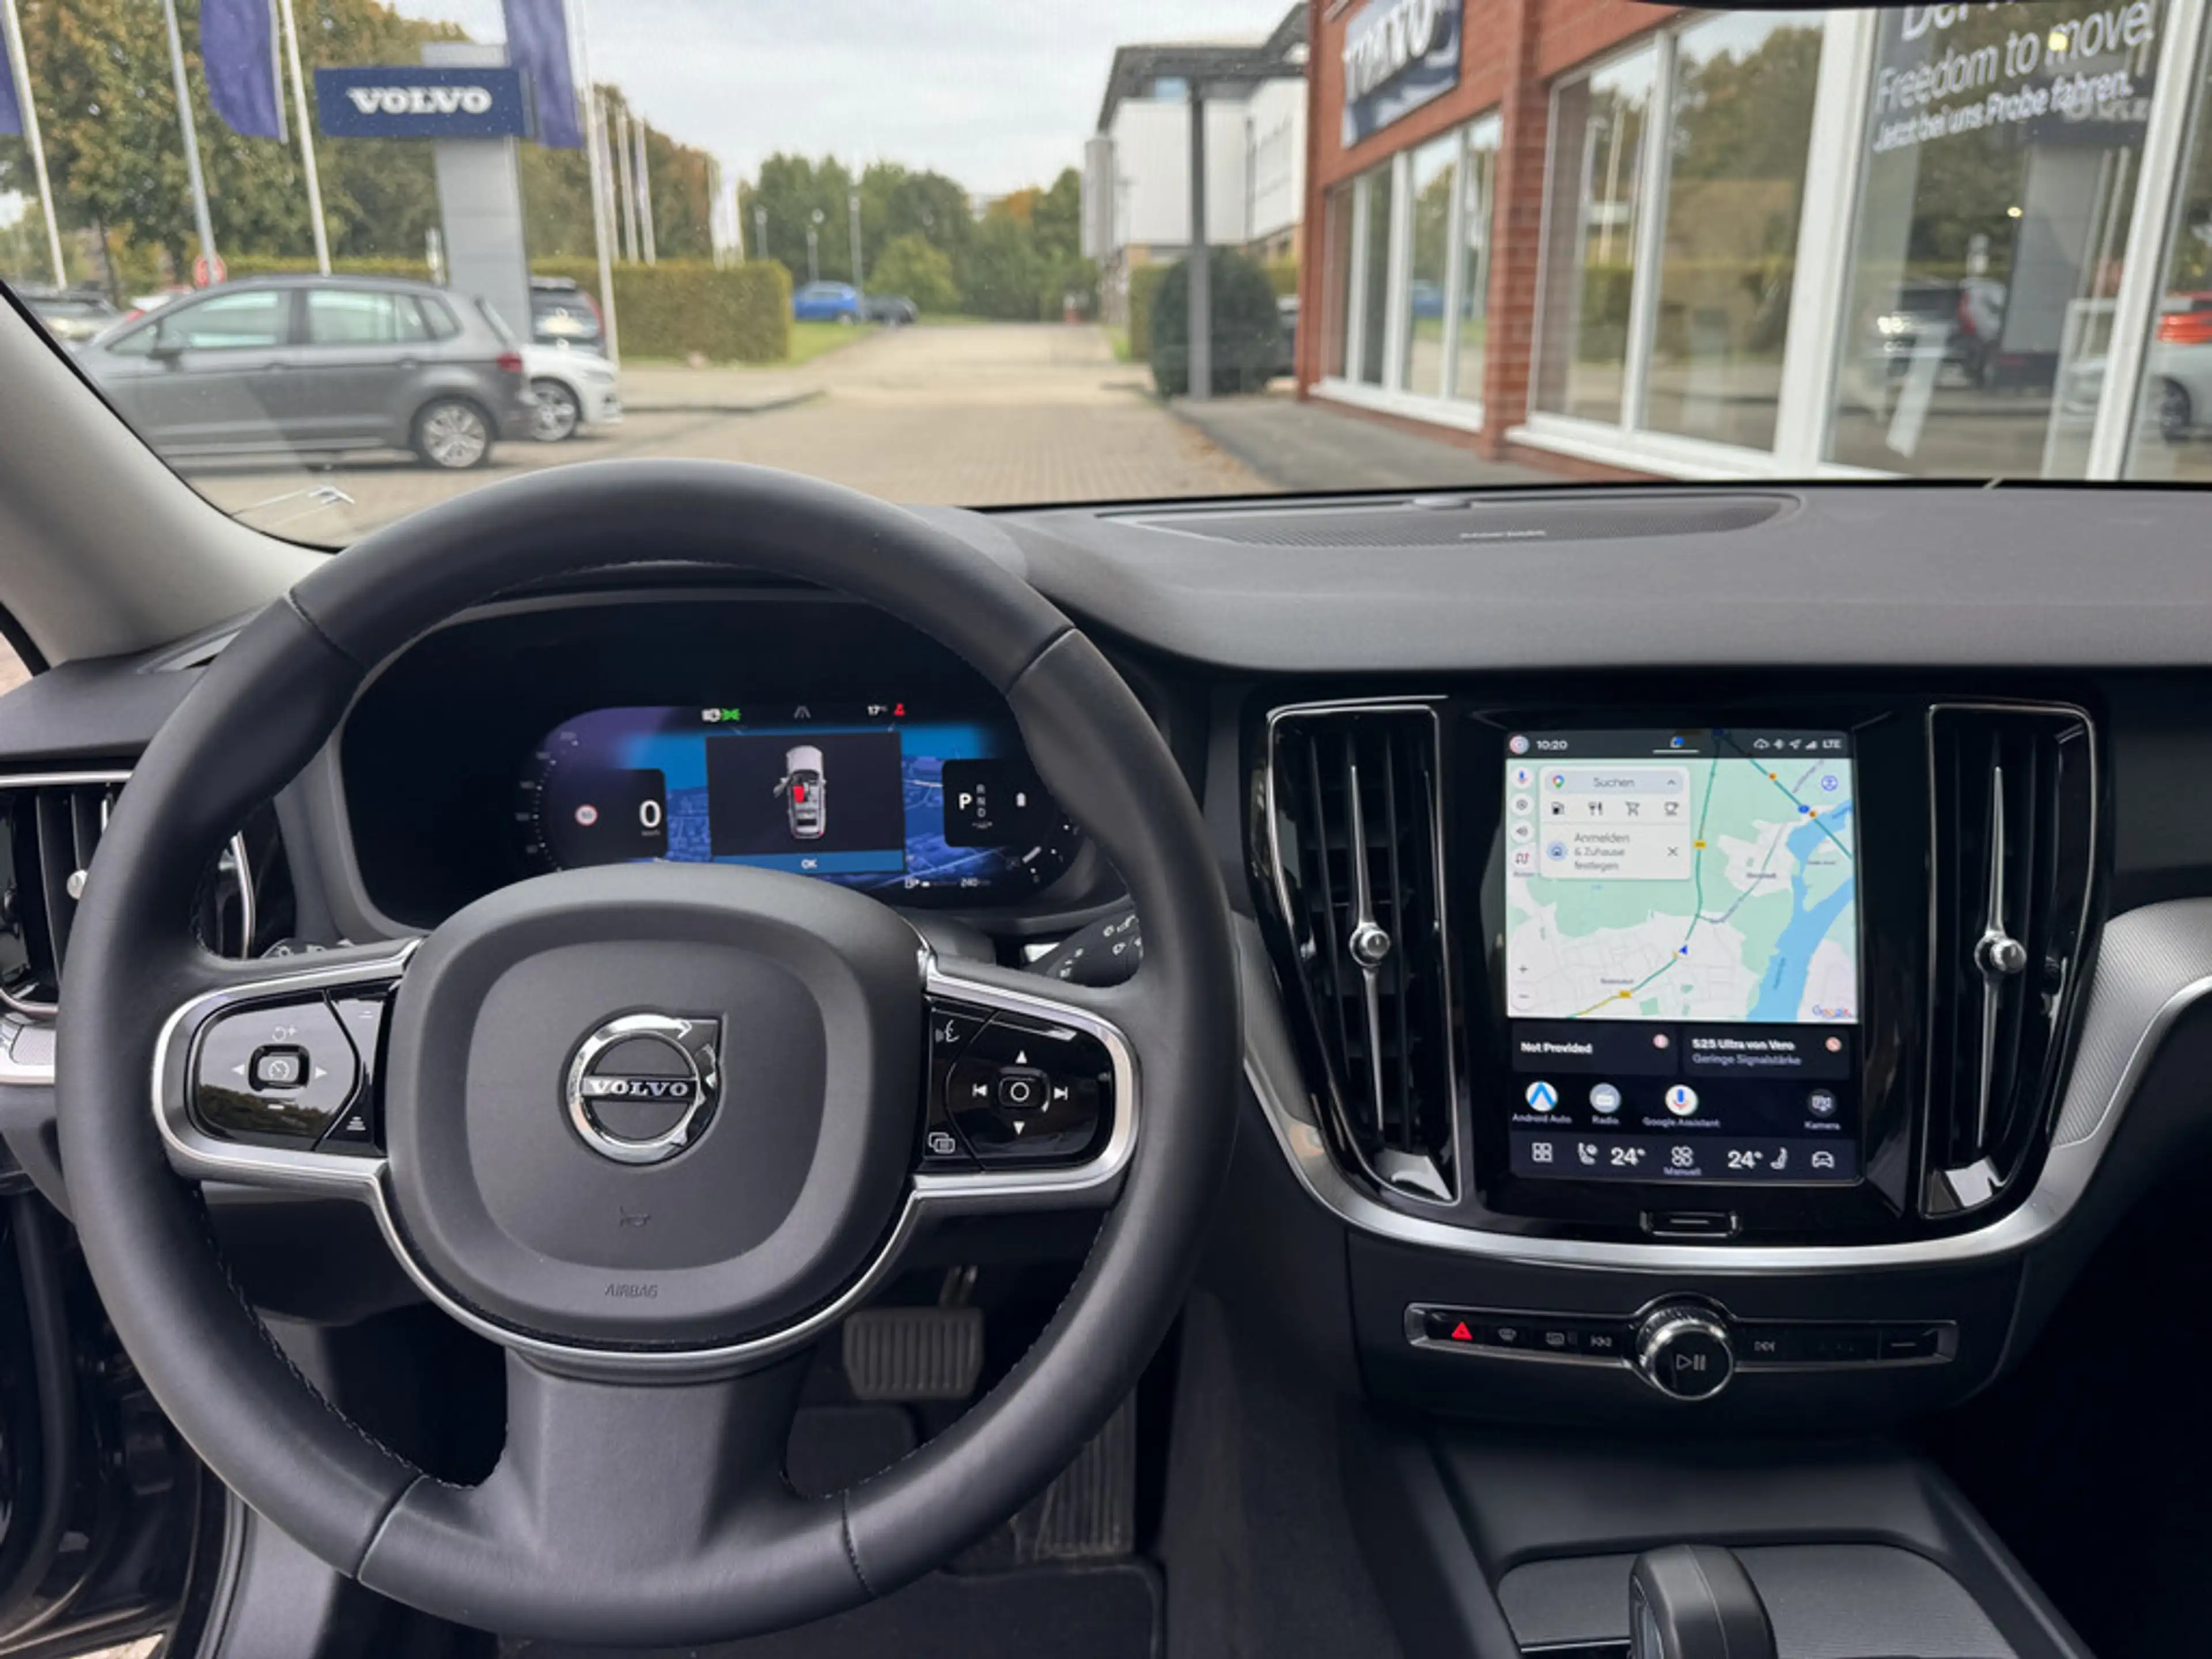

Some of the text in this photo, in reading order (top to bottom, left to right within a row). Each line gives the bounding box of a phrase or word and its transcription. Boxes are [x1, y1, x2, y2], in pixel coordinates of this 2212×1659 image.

[1875, 46, 1998, 113] Freedom
[2005, 31, 2040, 78] to
[348, 86, 493, 114] VOLVO
[1986, 84, 2049, 126] Probe
[1536, 740, 1567, 751] 10:20
[1822, 739, 1842, 749] LTE
[1593, 777, 1635, 787] Suchen
[959, 793, 972, 810] P
[639, 800, 661, 828] 0
[1574, 832, 1630, 844] Anmelden
[1584, 846, 1626, 857] Zuhause
[1521, 1042, 1593, 1054] Not Provided
[1717, 1039, 1745, 1050] Ultra
[1745, 1041, 1767, 1050] von
[1768, 1040, 1795, 1051] Vero
[1692, 1054, 1802, 1067] Geringe Signalstärke
[590, 1080, 689, 1097] VOLVO
[1512, 1113, 1548, 1124] Android
[1642, 1116, 1676, 1128] Google
[1804, 1120, 1840, 1131] Kamera
[1611, 1147, 1647, 1166] 24°
[1728, 1150, 1763, 1169] 24°
[604, 1282, 658, 1299] AIRBAG
